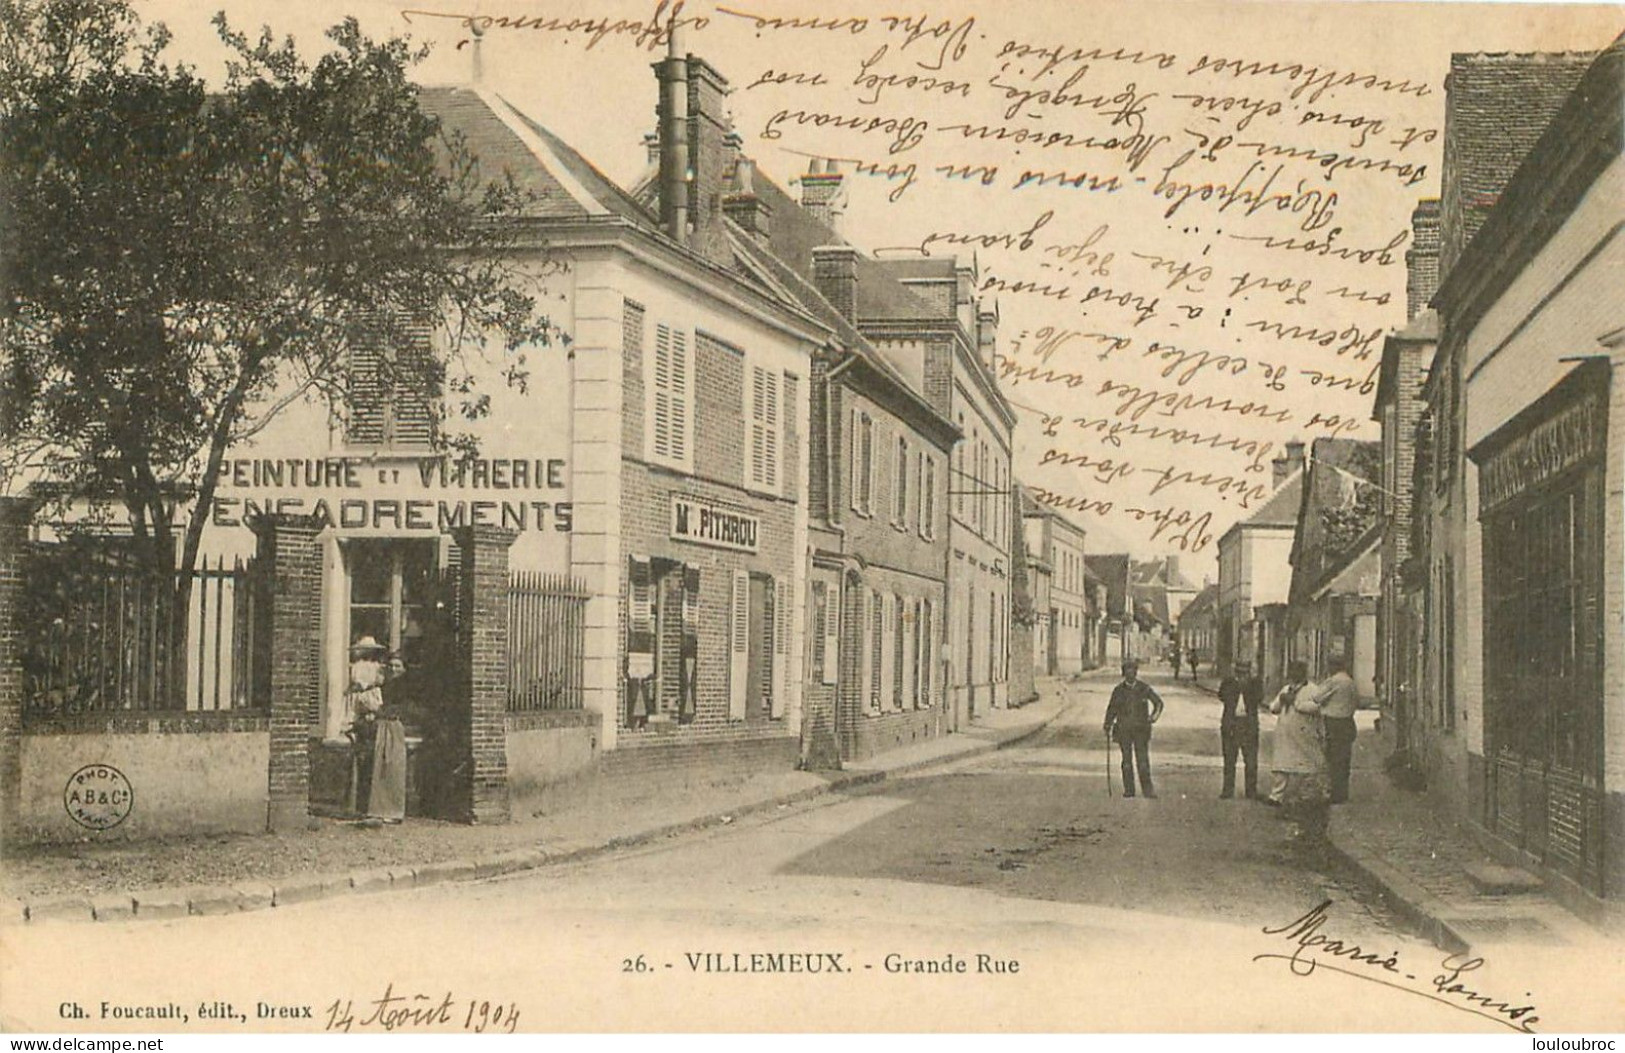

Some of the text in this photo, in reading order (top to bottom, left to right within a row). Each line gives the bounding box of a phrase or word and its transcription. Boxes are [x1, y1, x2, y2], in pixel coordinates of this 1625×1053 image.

[730, 8, 868, 37] amie
[881, 15, 975, 70] Votre
[745, 69, 827, 91] nos
[856, 45, 970, 103] recevez
[1188, 55, 1431, 104] meilleures
[1172, 93, 1282, 131] chère
[760, 109, 1427, 187] souvenir de Monsieur Besnard
[1391, 127, 1438, 150] et
[873, 209, 1391, 306] on doit être déjà grand
[1229, 227, 1409, 266] garçon
[1080, 287, 1159, 328] trois
[1170, 305, 1204, 327] à
[1084, 332, 1131, 360] de
[1148, 342, 1248, 387] celles
[1258, 362, 1287, 391] de
[1300, 362, 1382, 395] que
[1101, 379, 1290, 424] nouvelles
[1019, 407, 1273, 472] demander de
[1305, 413, 1359, 441] vos
[215, 457, 566, 489] PEINTURE ET VITRERIE
[1041, 450, 1266, 508] vient vous
[1025, 486, 1213, 552] Votre amie
[326, 999, 354, 1033] 14
[464, 1000, 521, 1033] 1904
